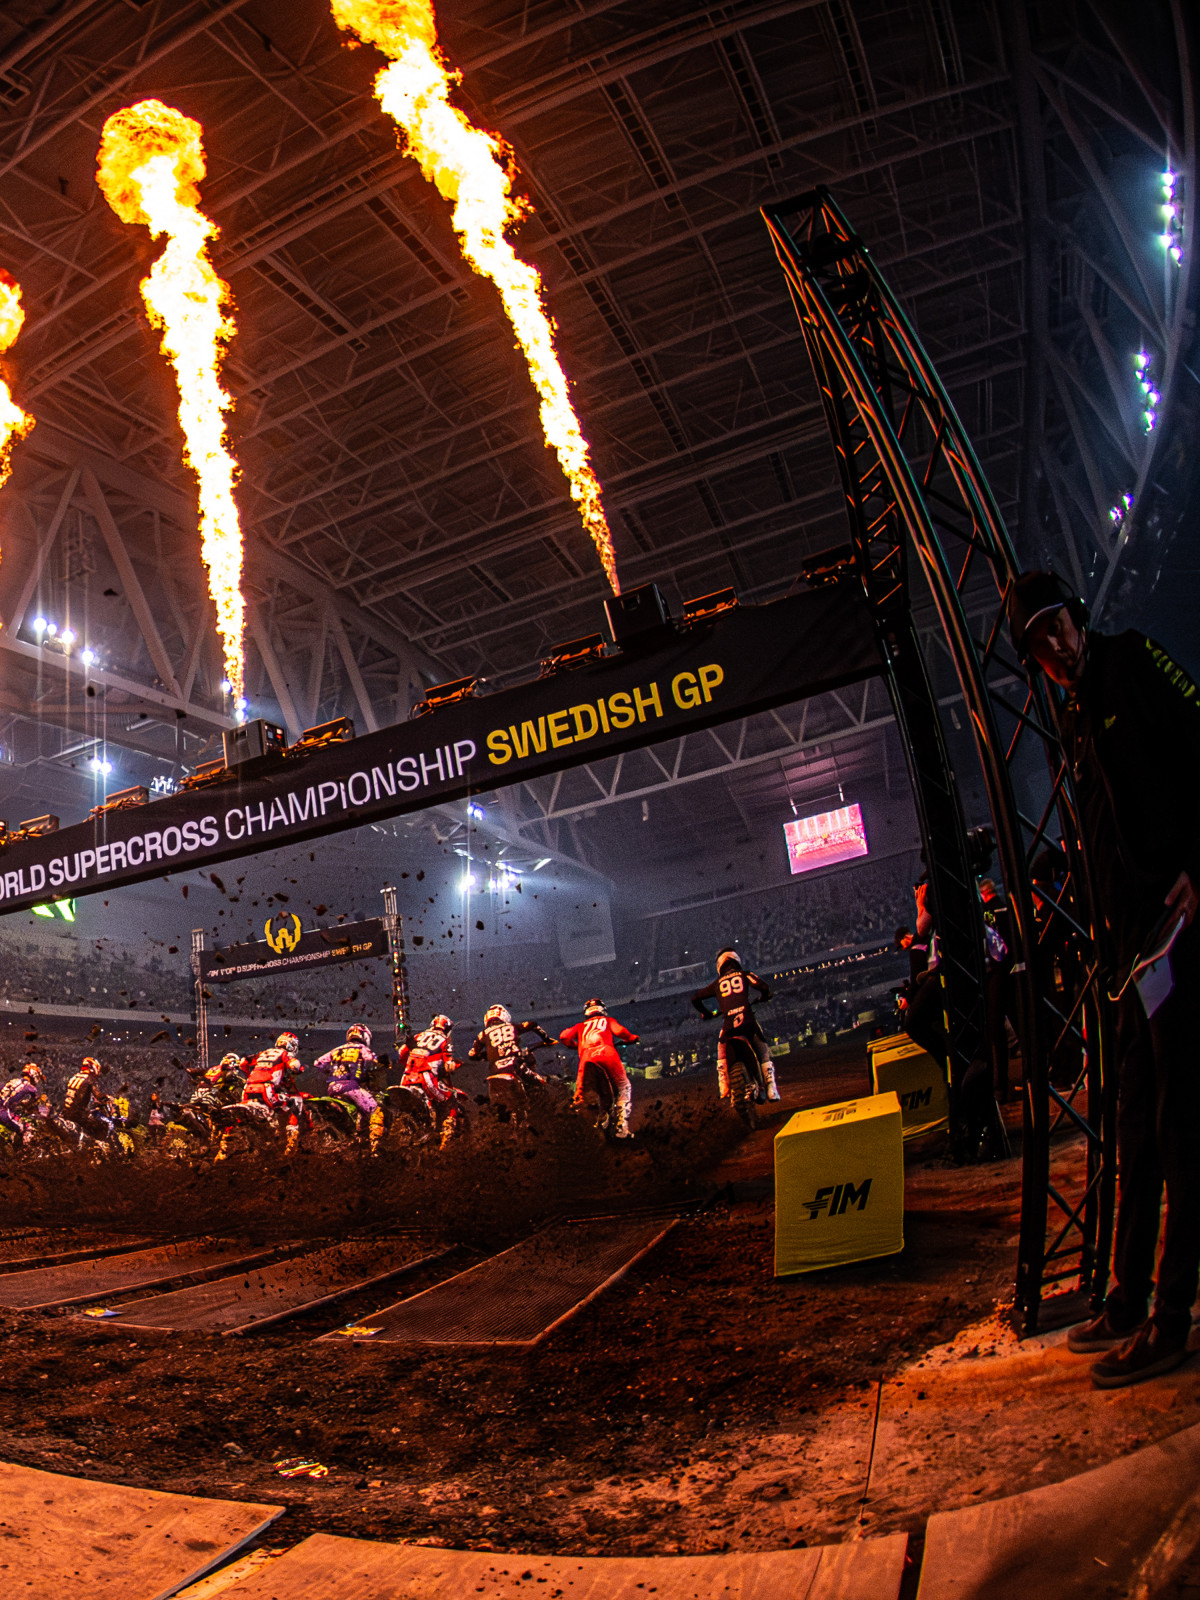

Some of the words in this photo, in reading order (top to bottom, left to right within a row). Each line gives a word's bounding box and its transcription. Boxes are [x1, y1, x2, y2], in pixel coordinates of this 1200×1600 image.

[48, 815, 220, 887] SUPERCROSS
[224, 739, 477, 840] CHAMPIONSHIP
[486, 681, 664, 766] SWEDISH
[671, 663, 725, 710] GP
[719, 976, 744, 998] 99
[801, 1178, 873, 1221] FIM
